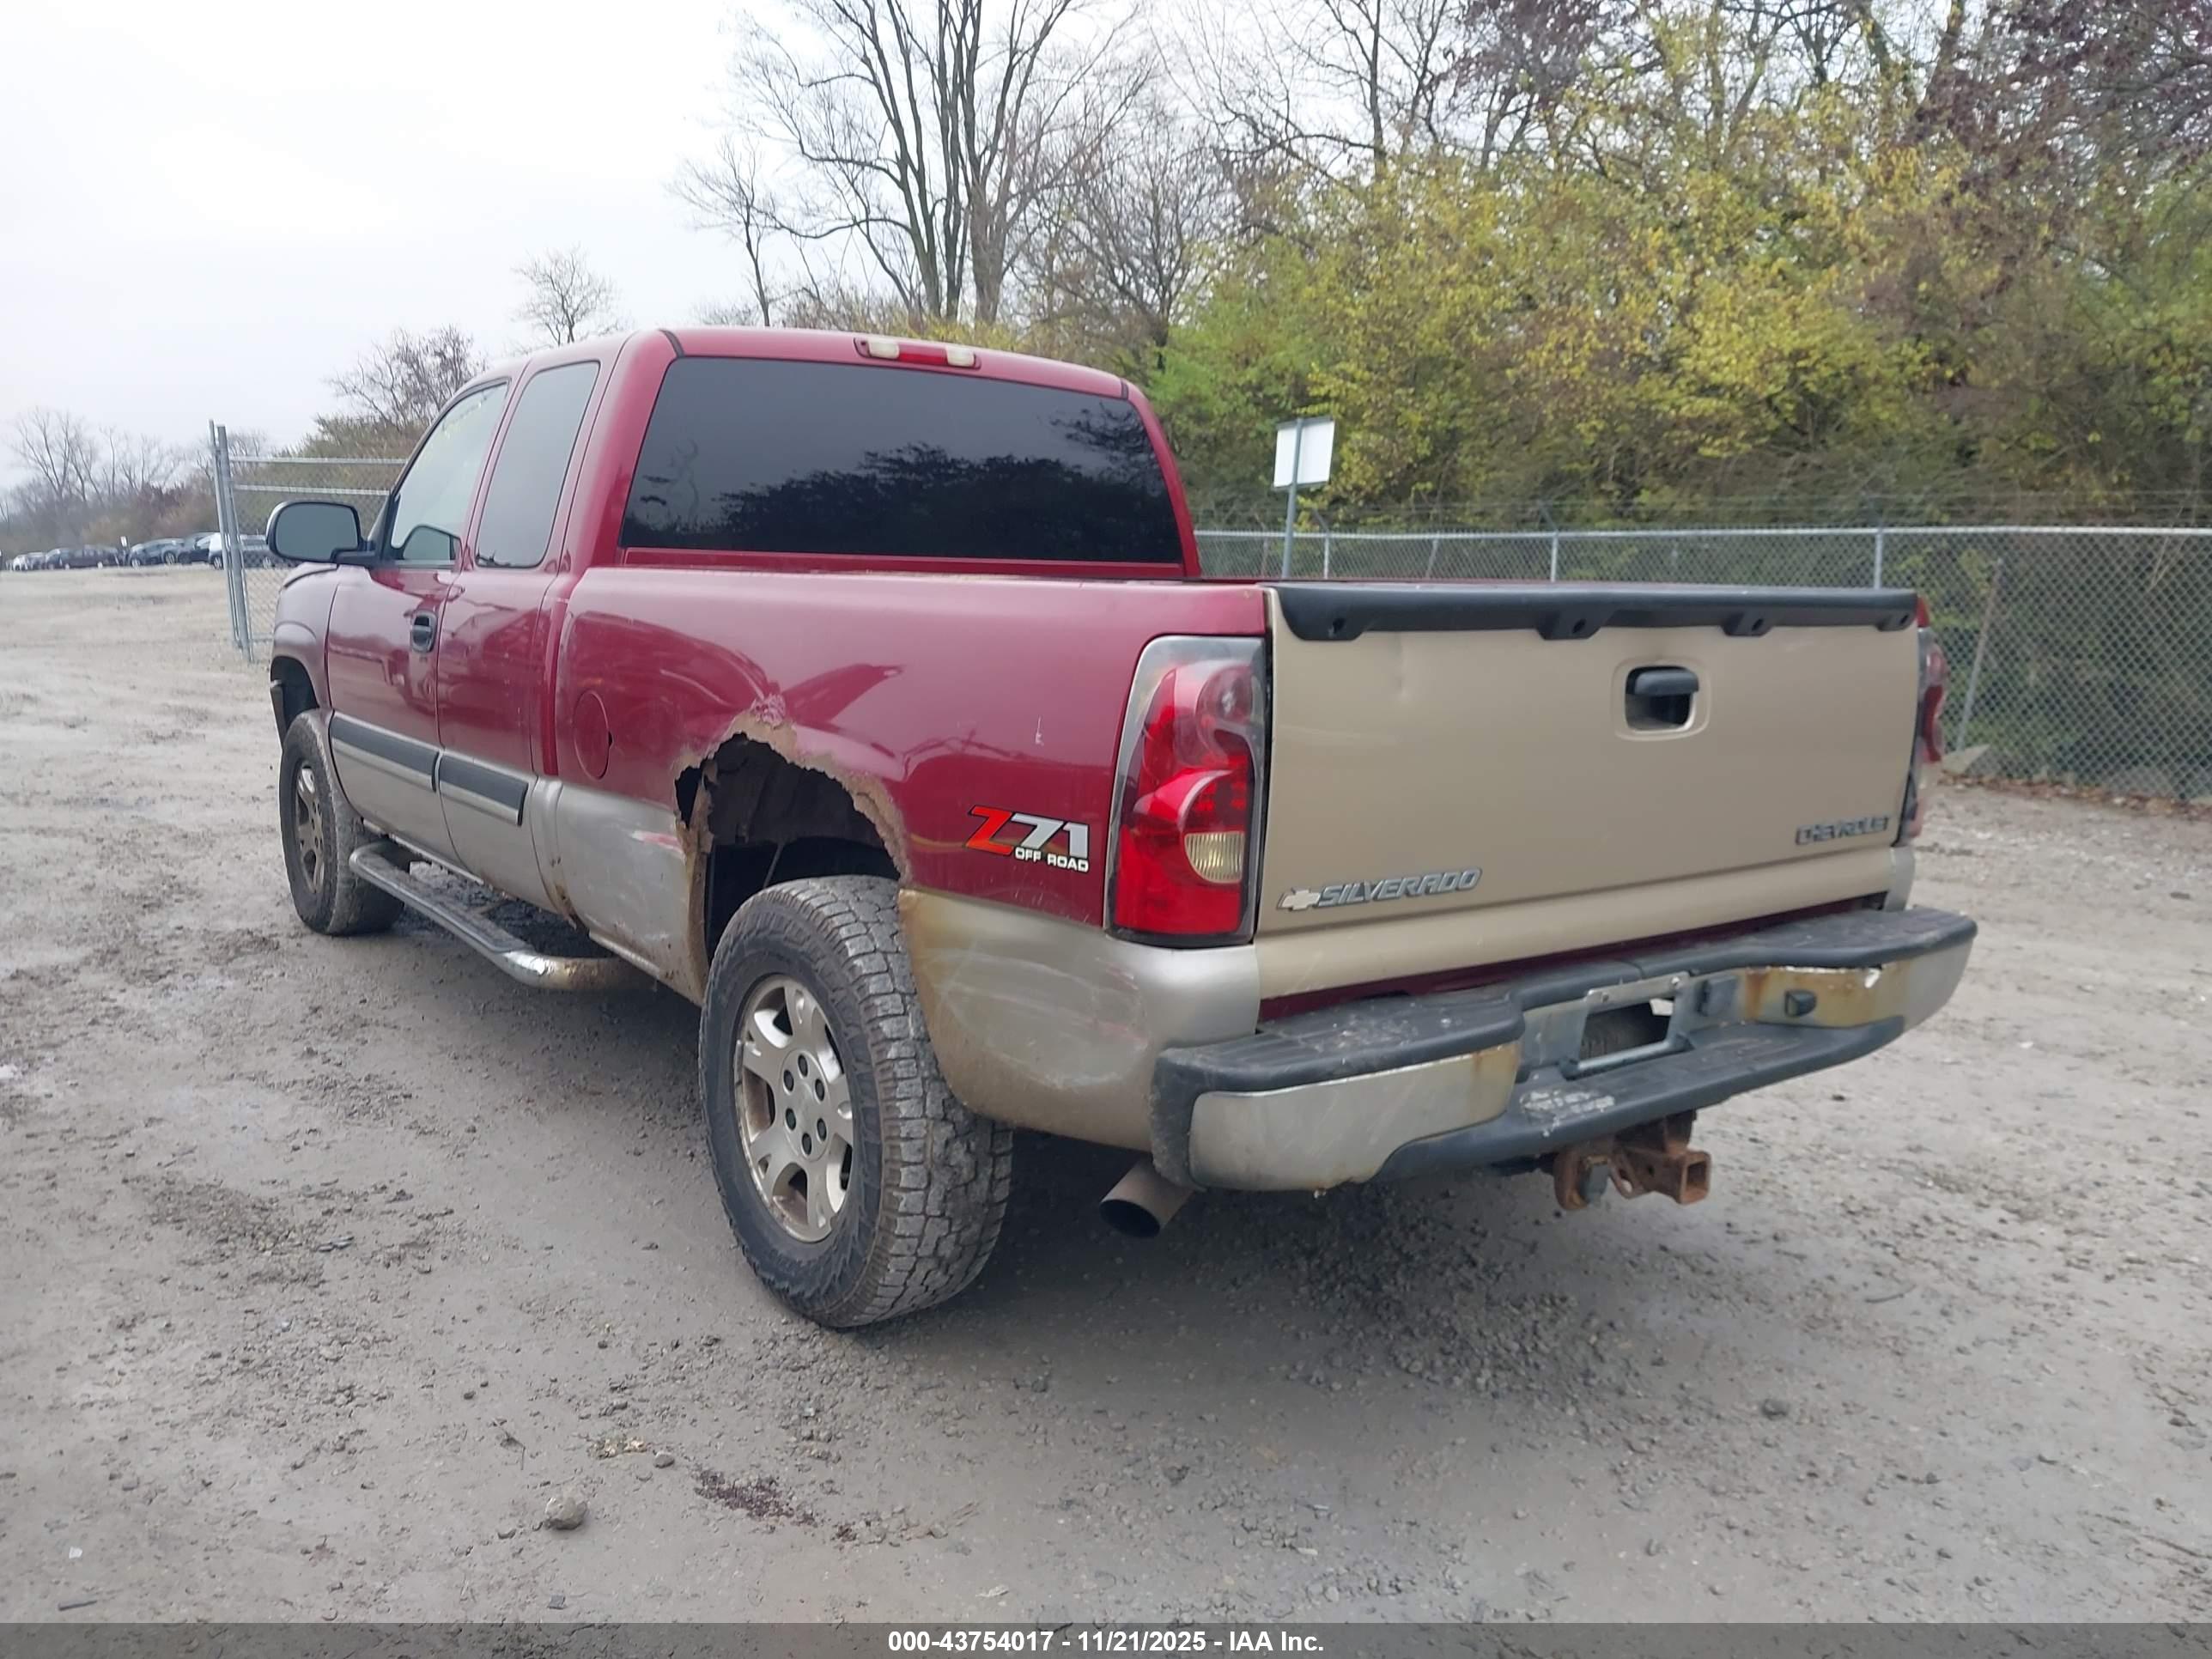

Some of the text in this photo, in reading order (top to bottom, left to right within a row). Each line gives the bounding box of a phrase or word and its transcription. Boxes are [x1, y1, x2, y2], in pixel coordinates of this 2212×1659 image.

[966, 805, 1089, 858] Z71
[1014, 846, 1089, 873] OFF ROAD
[1316, 867, 1483, 908] SILVERADO
